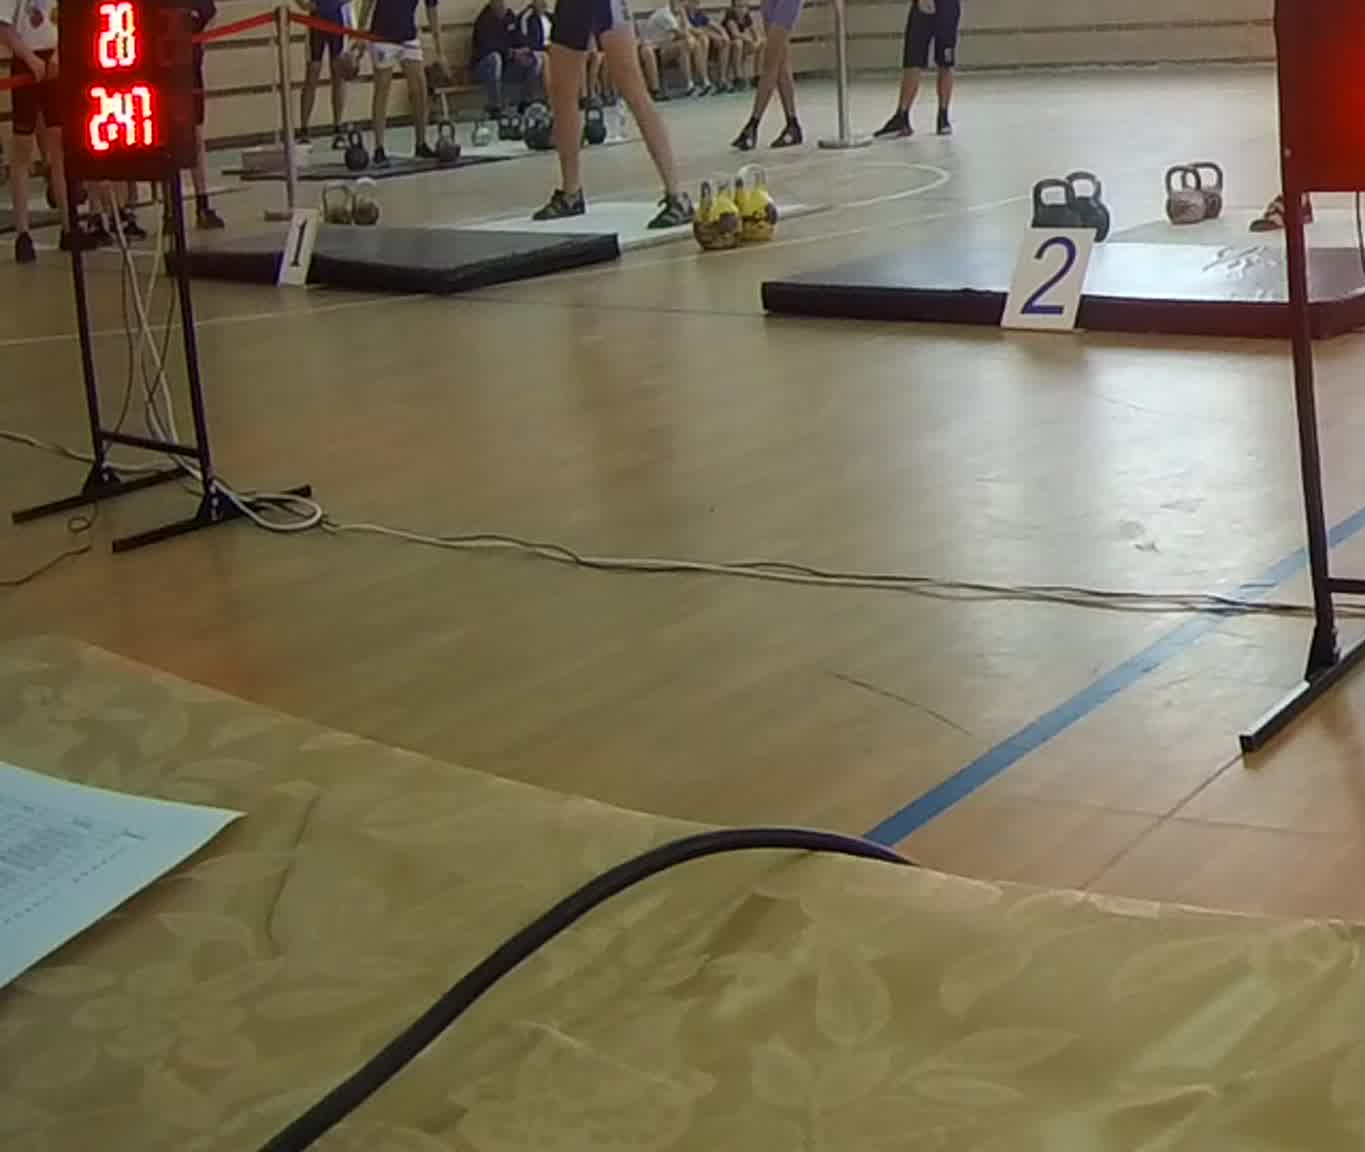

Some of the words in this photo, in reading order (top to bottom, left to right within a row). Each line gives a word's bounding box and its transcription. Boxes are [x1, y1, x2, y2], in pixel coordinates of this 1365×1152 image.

[89, 87, 153, 151] 2:47
[290, 218, 308, 267] 1
[1020, 236, 1076, 315] 2
